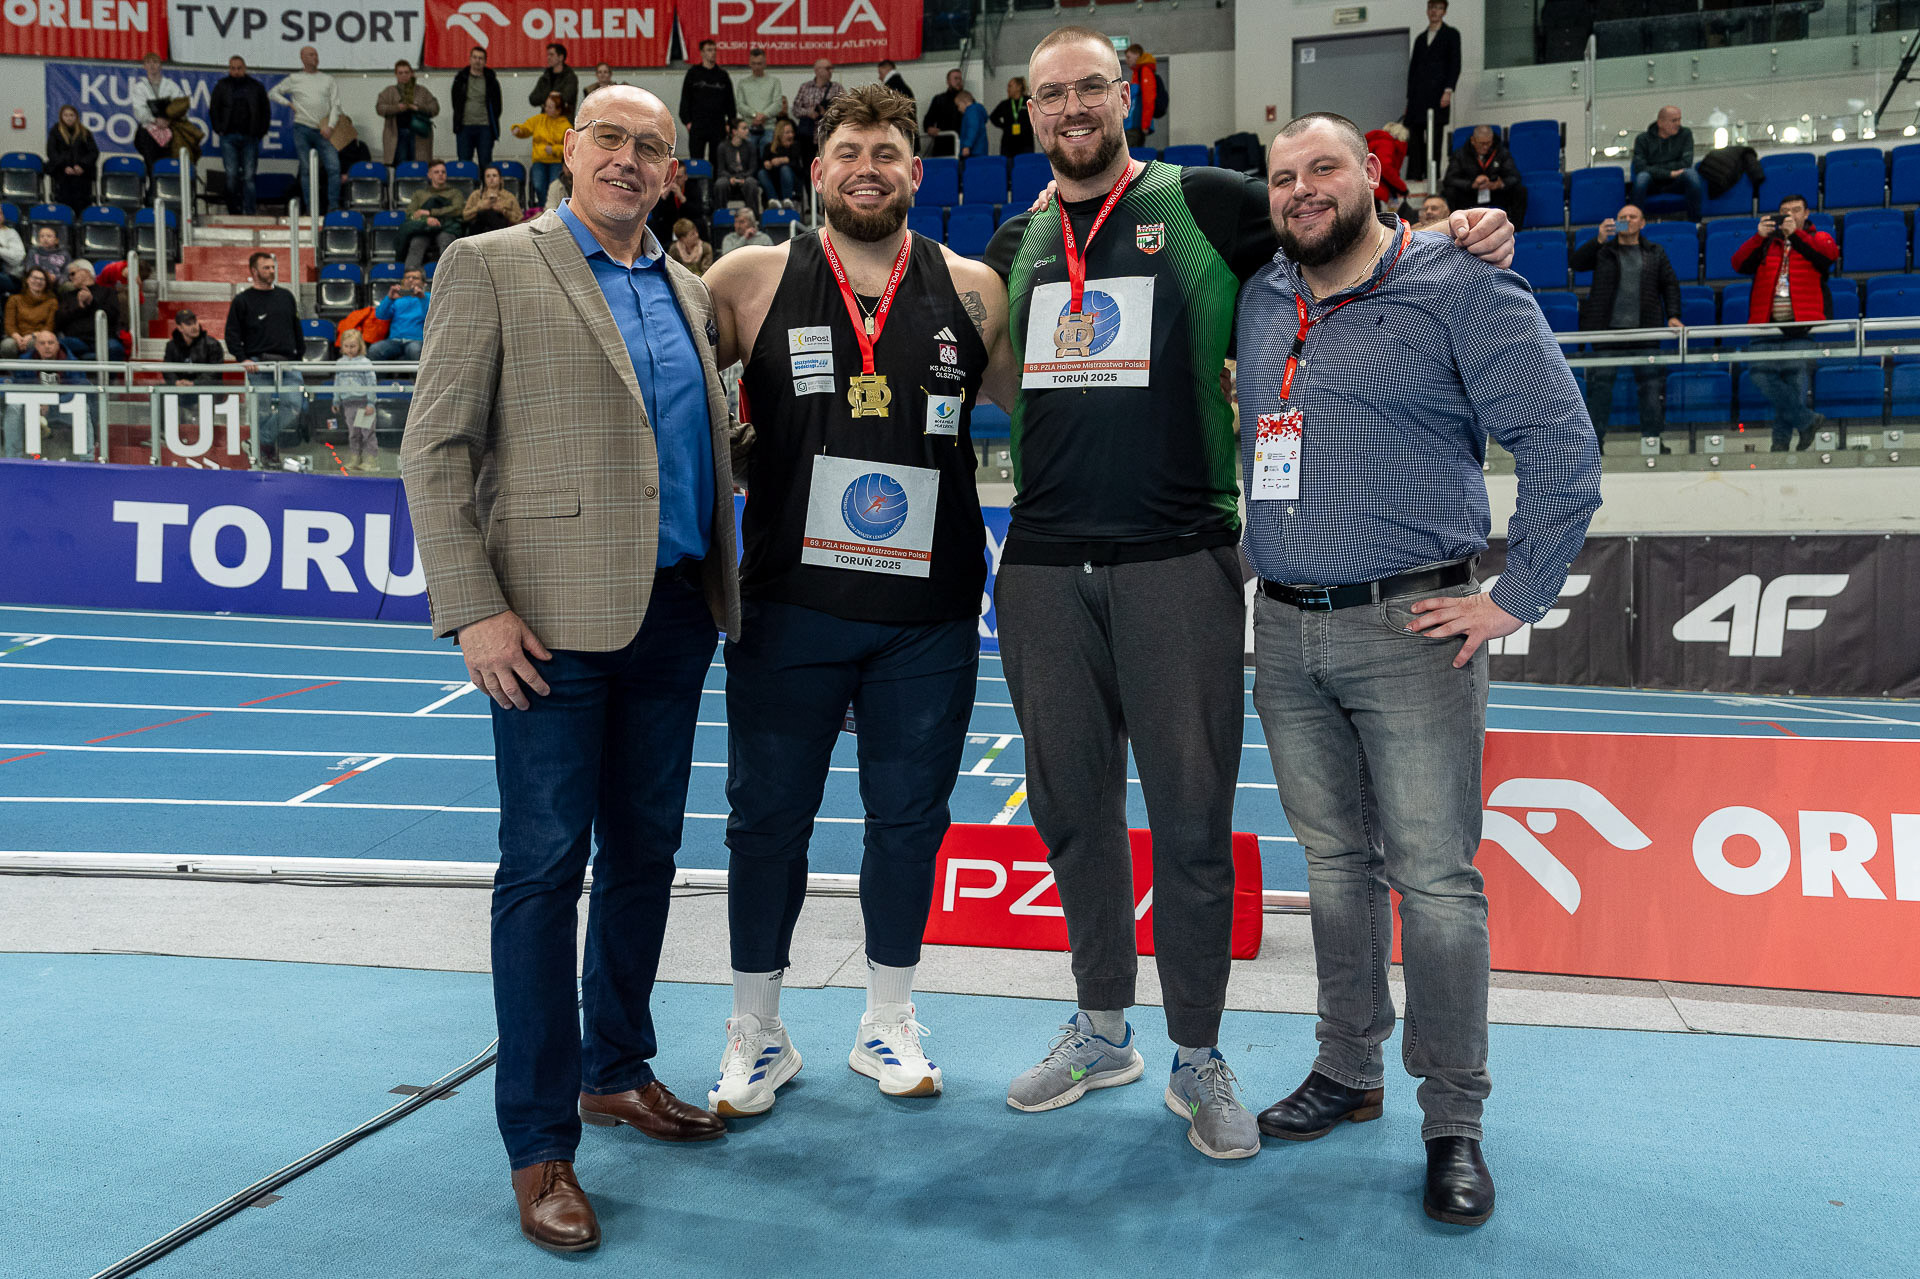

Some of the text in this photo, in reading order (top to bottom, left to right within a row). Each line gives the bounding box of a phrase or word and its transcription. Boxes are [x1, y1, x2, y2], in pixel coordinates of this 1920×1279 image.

[4, 0, 149, 32] ORLEN
[177, 4, 419, 43] TVP SPORT
[522, 8, 655, 39] ORLEN
[710, 0, 887, 35] PZLA
[885, 271, 901, 296] POLSKI
[880, 295, 893, 314] 2025
[804, 335, 830, 343] InPost
[935, 371, 961, 381] OLSZTYN
[1029, 359, 1146, 372] 69. PZLA Halowe Mistrzostwa Polski
[1052, 372, 1118, 384] TORUŃ 2025
[5, 392, 87, 454] T1
[164, 394, 241, 457] U1
[113, 500, 428, 598] TORU
[809, 539, 928, 560] 69. PZLA Halowe Mistrzostwa Polski
[834, 554, 901, 570] TORUŃ 2025
[1672, 574, 1850, 657] 4F
